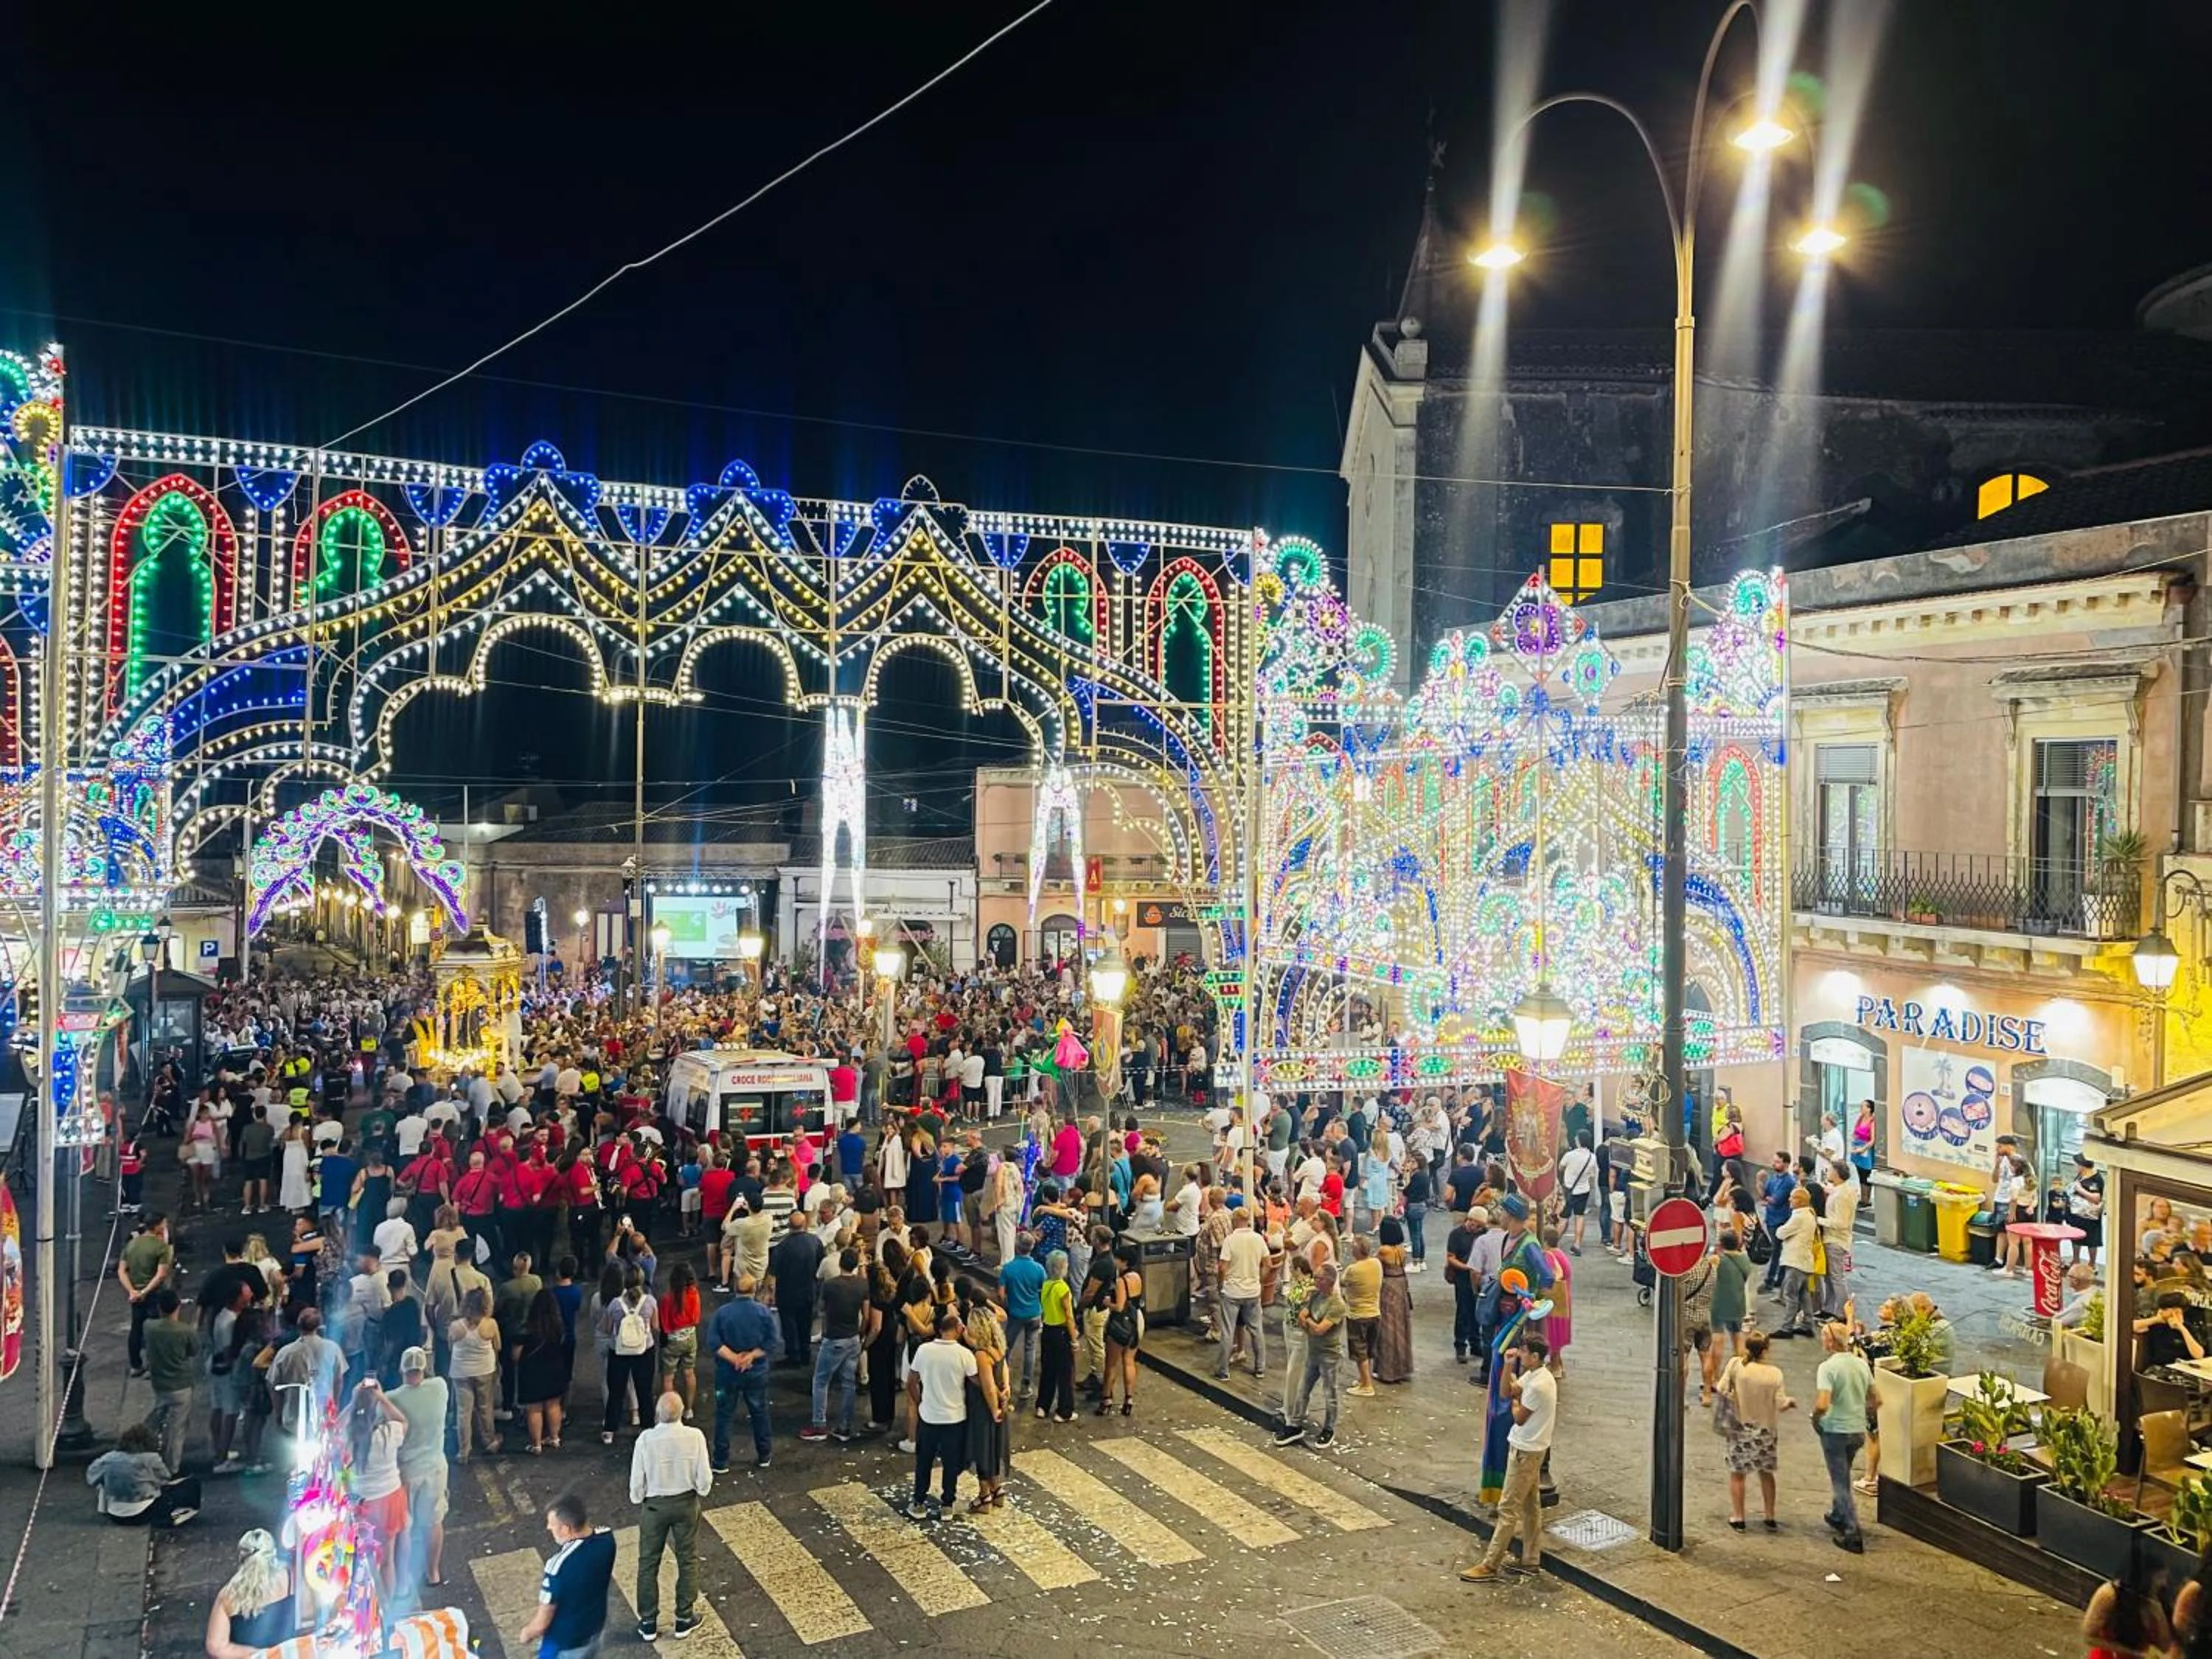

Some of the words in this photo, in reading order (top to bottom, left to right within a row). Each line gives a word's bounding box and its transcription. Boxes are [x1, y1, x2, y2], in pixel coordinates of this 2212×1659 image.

[204, 942, 215, 955] P
[1856, 995, 2048, 1054] PARADISE
[731, 1074, 756, 1085] CROCE
